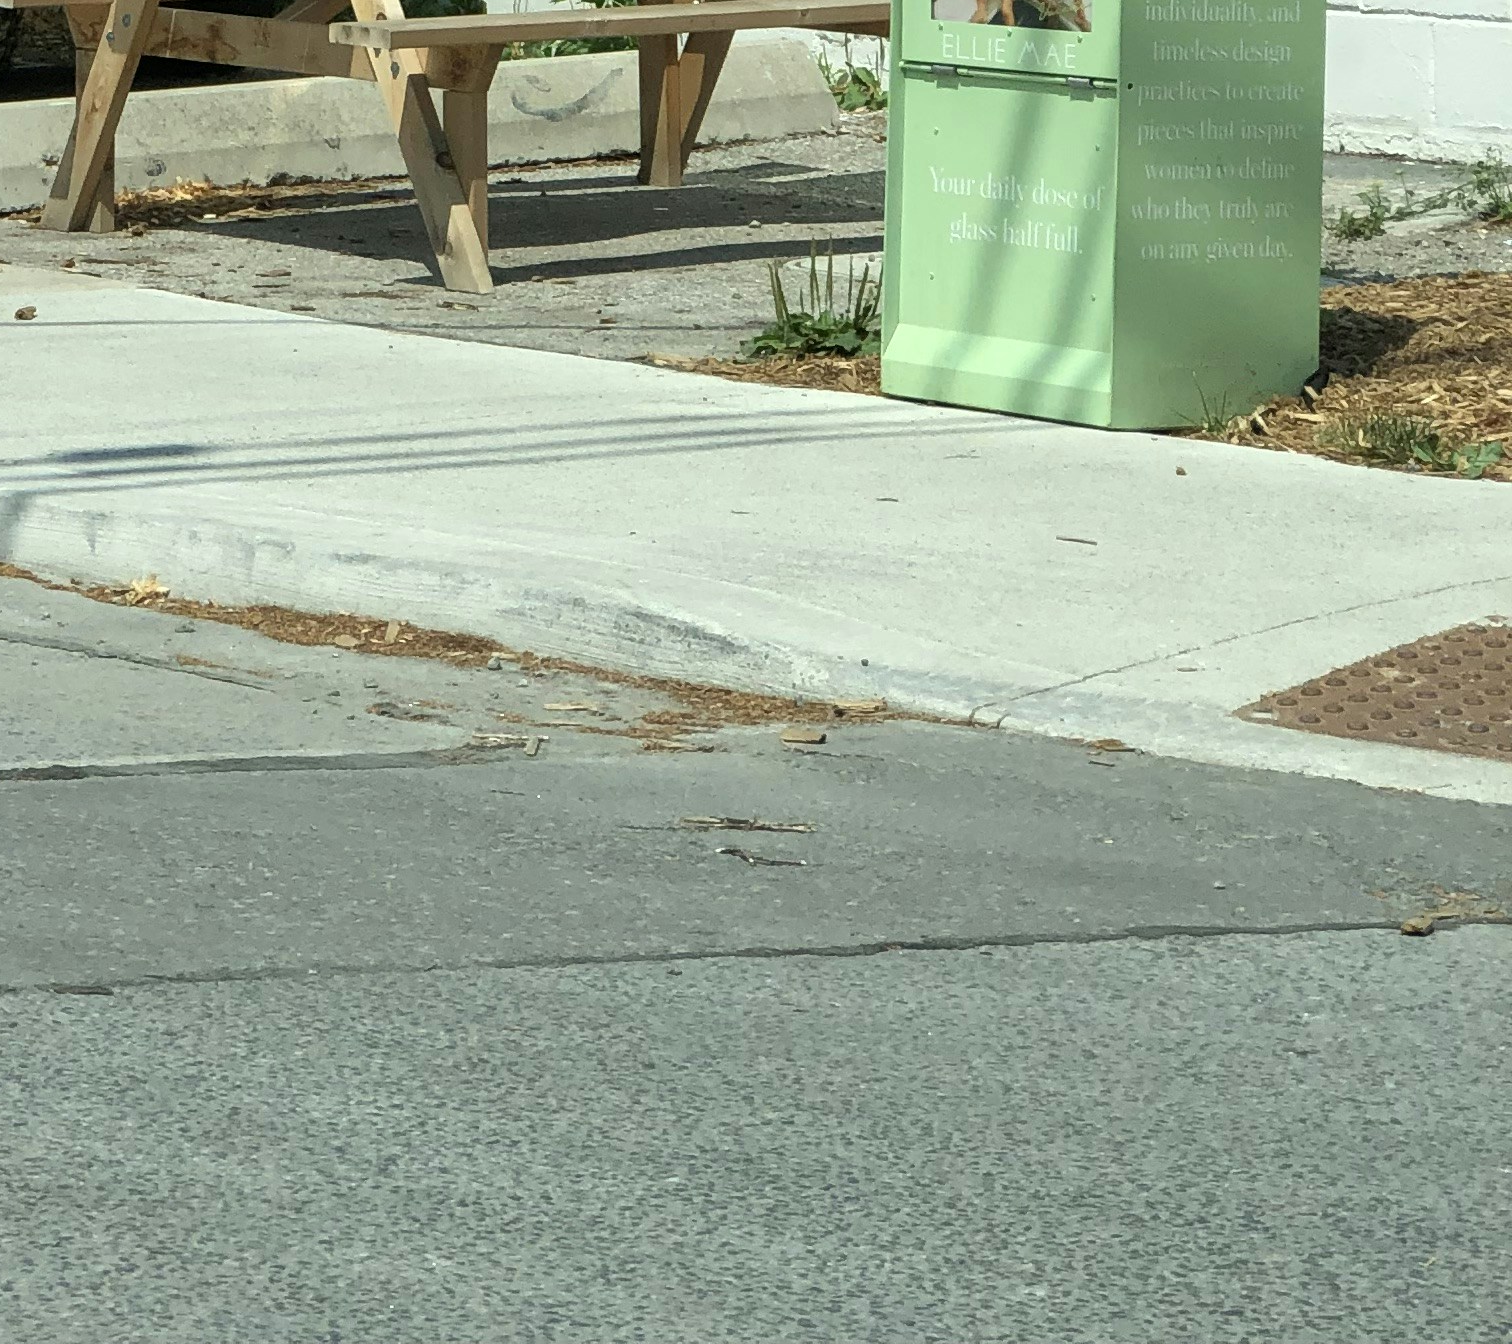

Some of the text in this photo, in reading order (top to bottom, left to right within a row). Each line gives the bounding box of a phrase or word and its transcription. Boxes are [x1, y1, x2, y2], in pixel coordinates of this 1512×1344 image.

[1266, 0, 1302, 24] and
[942, 33, 1077, 69] ELLIE MAE
[1153, 37, 1292, 67] timeless design
[1137, 80, 1305, 107] practices to create
[1137, 117, 1304, 146] pieces that inspire
[1144, 162, 1212, 181] women
[1238, 156, 1295, 182] define
[929, 166, 1106, 211] Your daily dose of
[1131, 196, 1296, 226] who they truly are
[949, 212, 1084, 255] glass half full.
[1141, 242, 1165, 260] on
[1169, 242, 1200, 264] any
[1206, 236, 1255, 264] given
